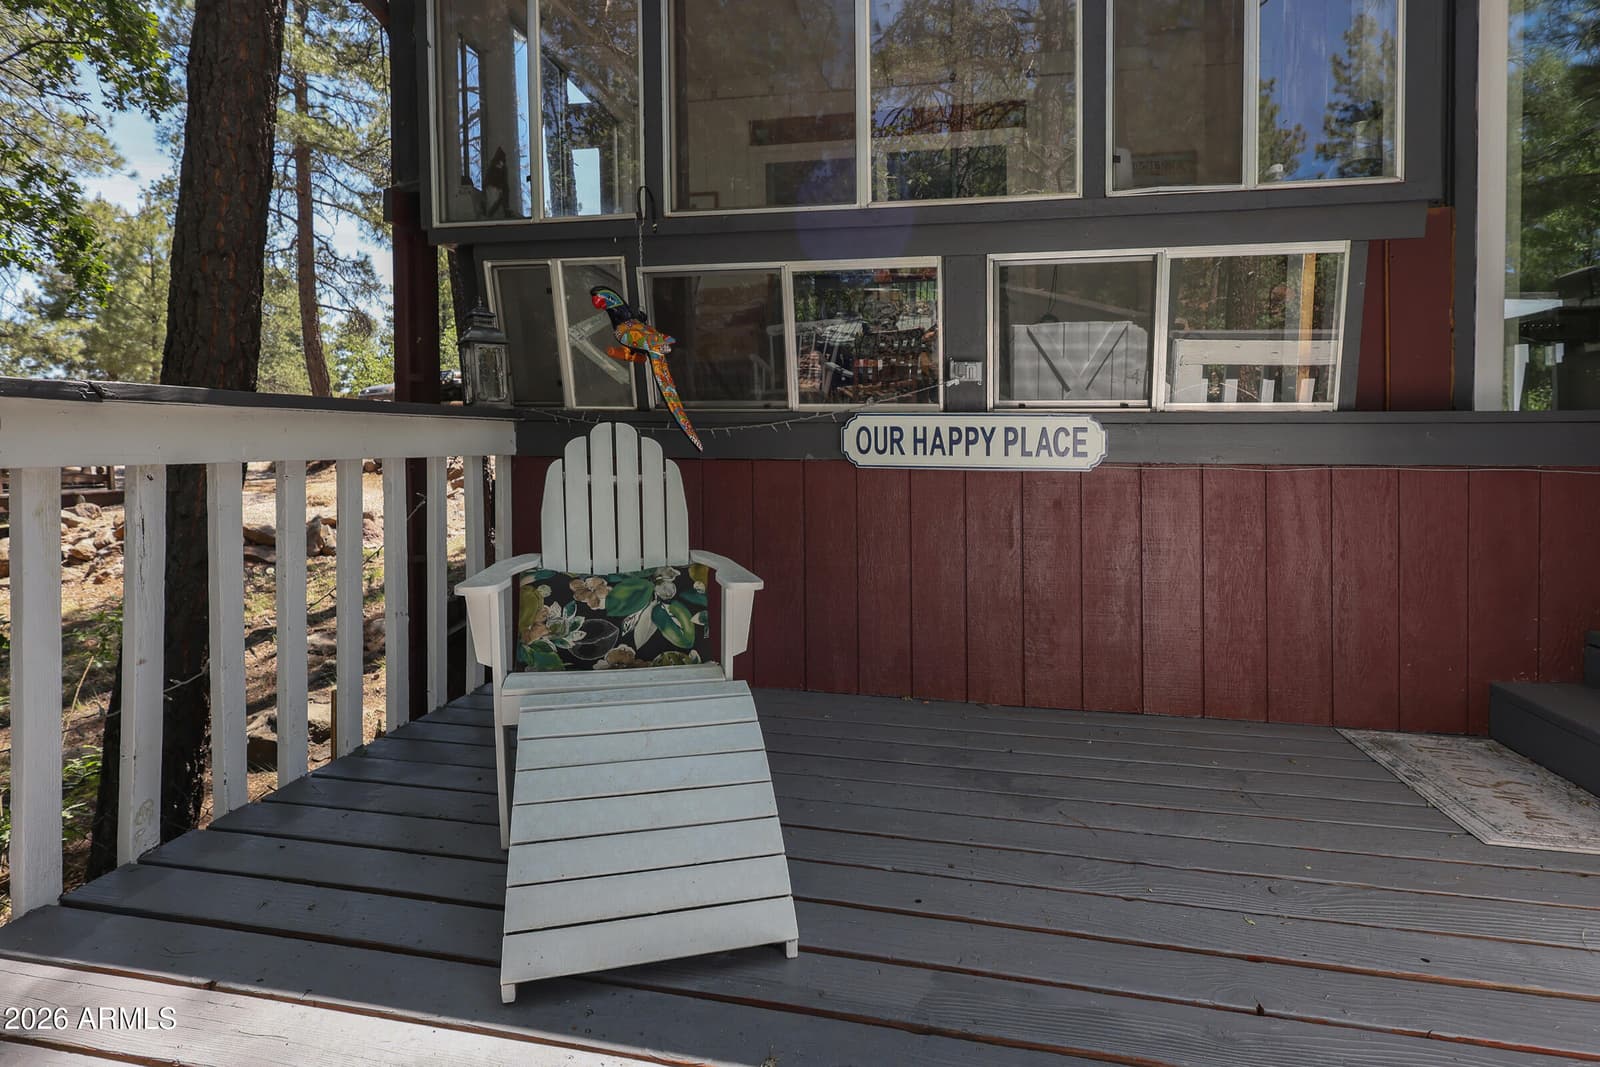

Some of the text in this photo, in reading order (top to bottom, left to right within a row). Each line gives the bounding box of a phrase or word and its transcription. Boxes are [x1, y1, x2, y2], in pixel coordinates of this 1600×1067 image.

[855, 426, 1089, 458] OUR HAPPY PLACE
